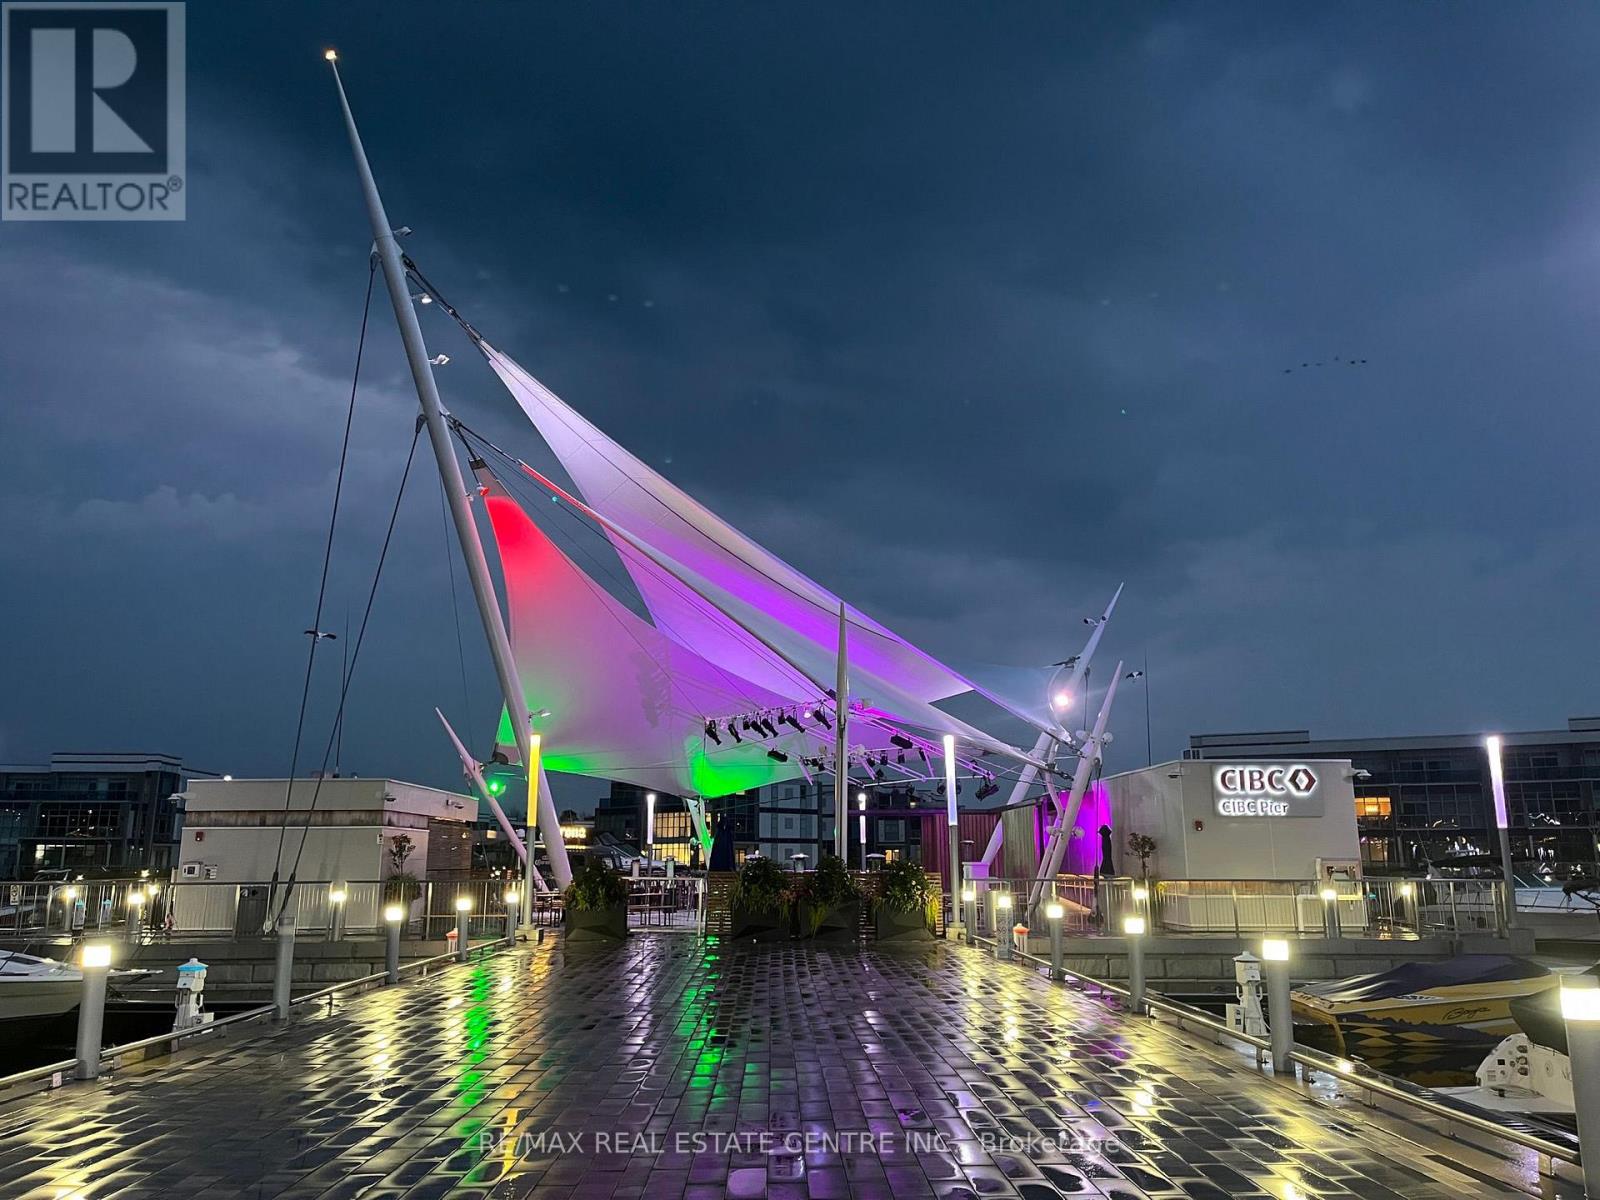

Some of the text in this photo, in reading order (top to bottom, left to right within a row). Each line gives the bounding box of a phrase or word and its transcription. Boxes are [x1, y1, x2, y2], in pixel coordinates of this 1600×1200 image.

[1220, 768, 1286, 792] CIBC
[1221, 800, 1288, 814] CIBC Pier
